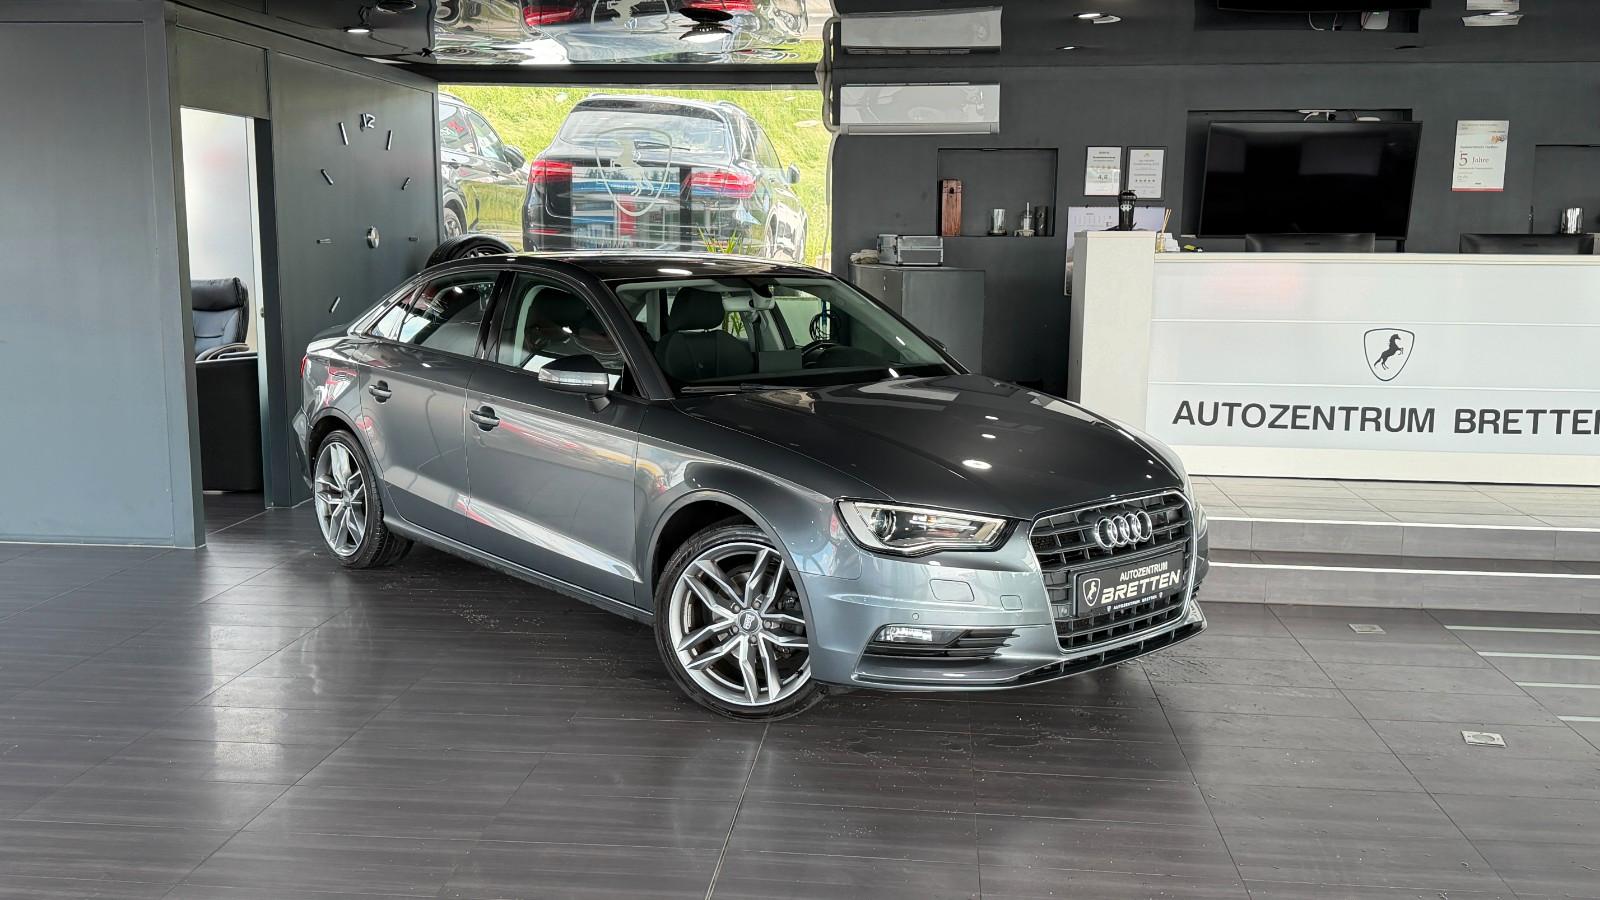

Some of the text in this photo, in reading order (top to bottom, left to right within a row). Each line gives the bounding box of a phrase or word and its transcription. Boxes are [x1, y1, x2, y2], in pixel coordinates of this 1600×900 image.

[361, 112, 376, 129] 12
[1459, 152, 1468, 167] 5
[1171, 400, 1600, 435] AUTOZENTRUM BRETTE
[1119, 561, 1168, 582] AUTOZENTRUM
[1101, 569, 1181, 604] BRETTEN
